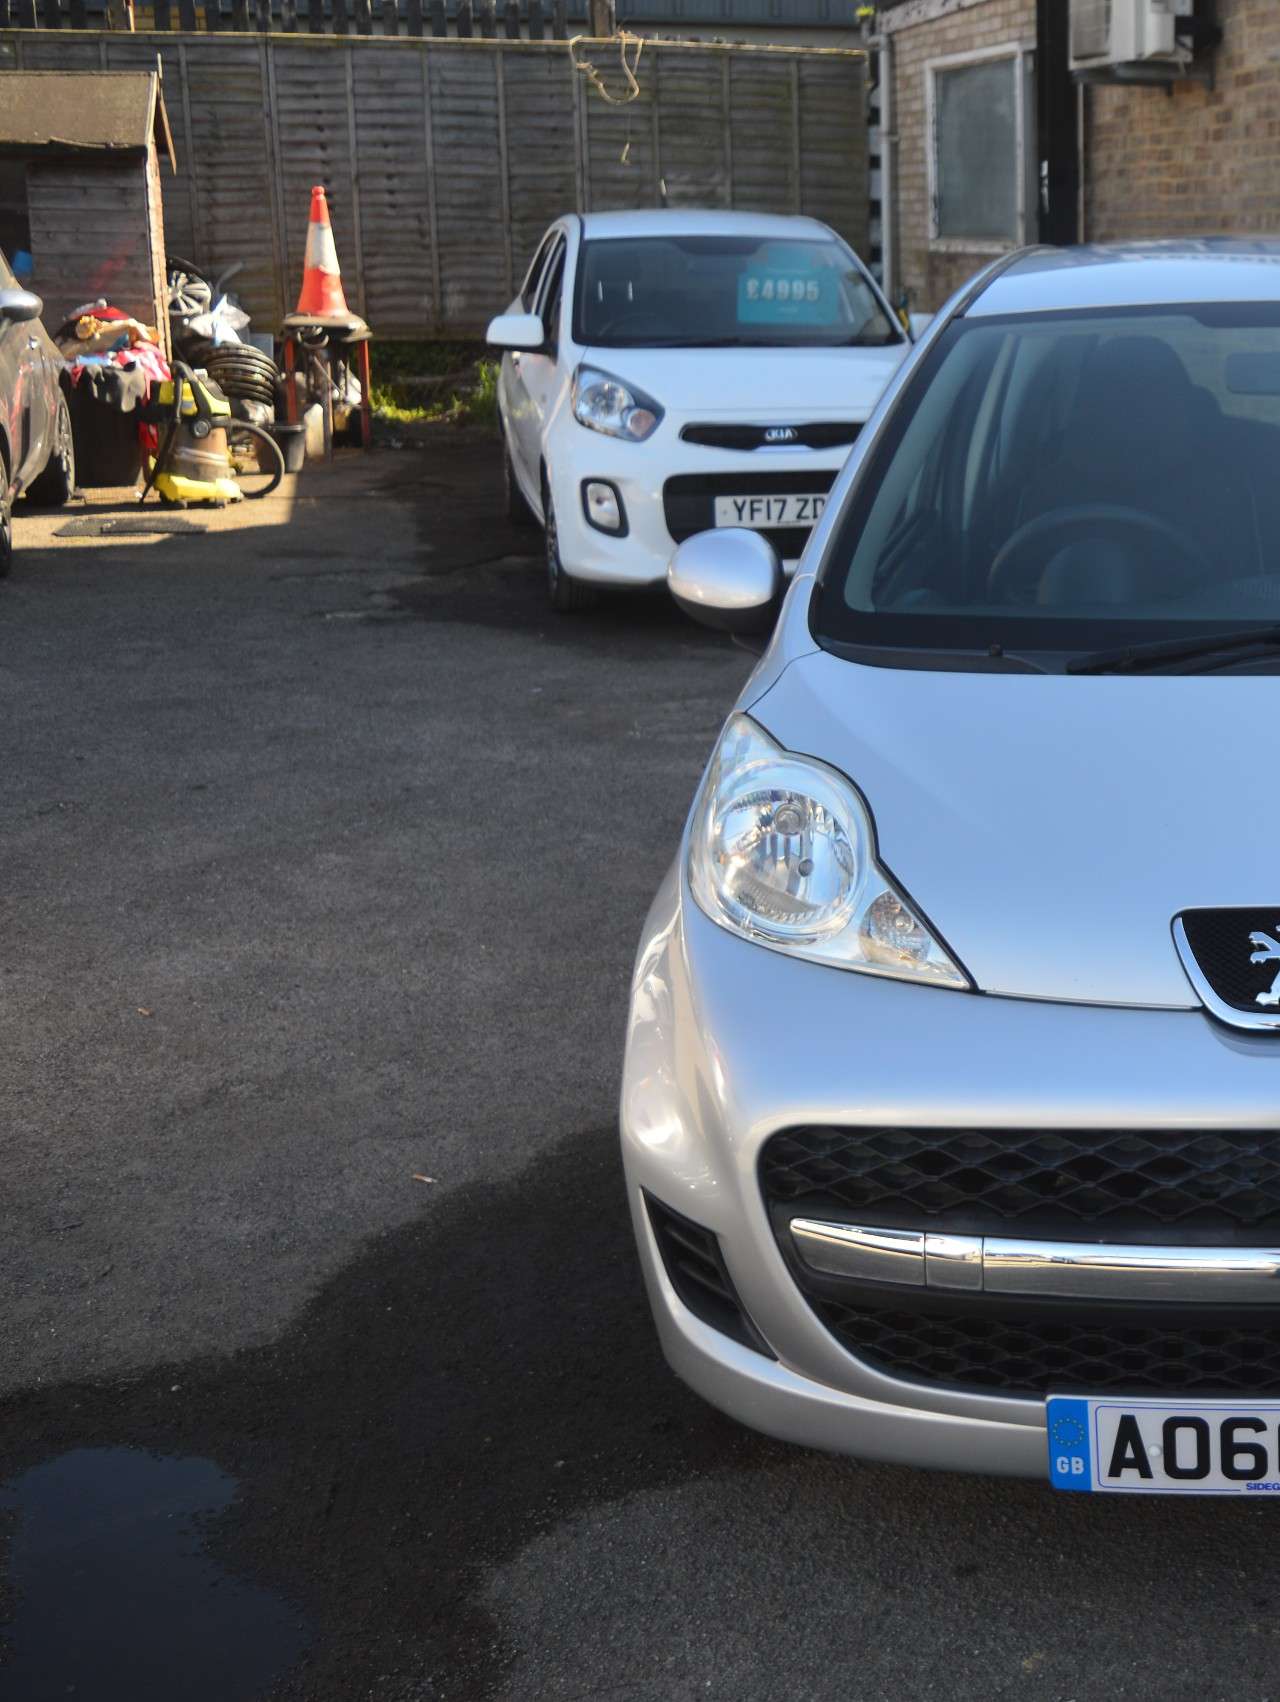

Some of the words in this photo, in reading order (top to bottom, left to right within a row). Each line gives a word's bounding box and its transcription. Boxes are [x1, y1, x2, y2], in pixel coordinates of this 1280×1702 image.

[768, 428, 796, 441] KIA
[733, 498, 787, 522] YF17
[1056, 1456, 1084, 1475] GB
